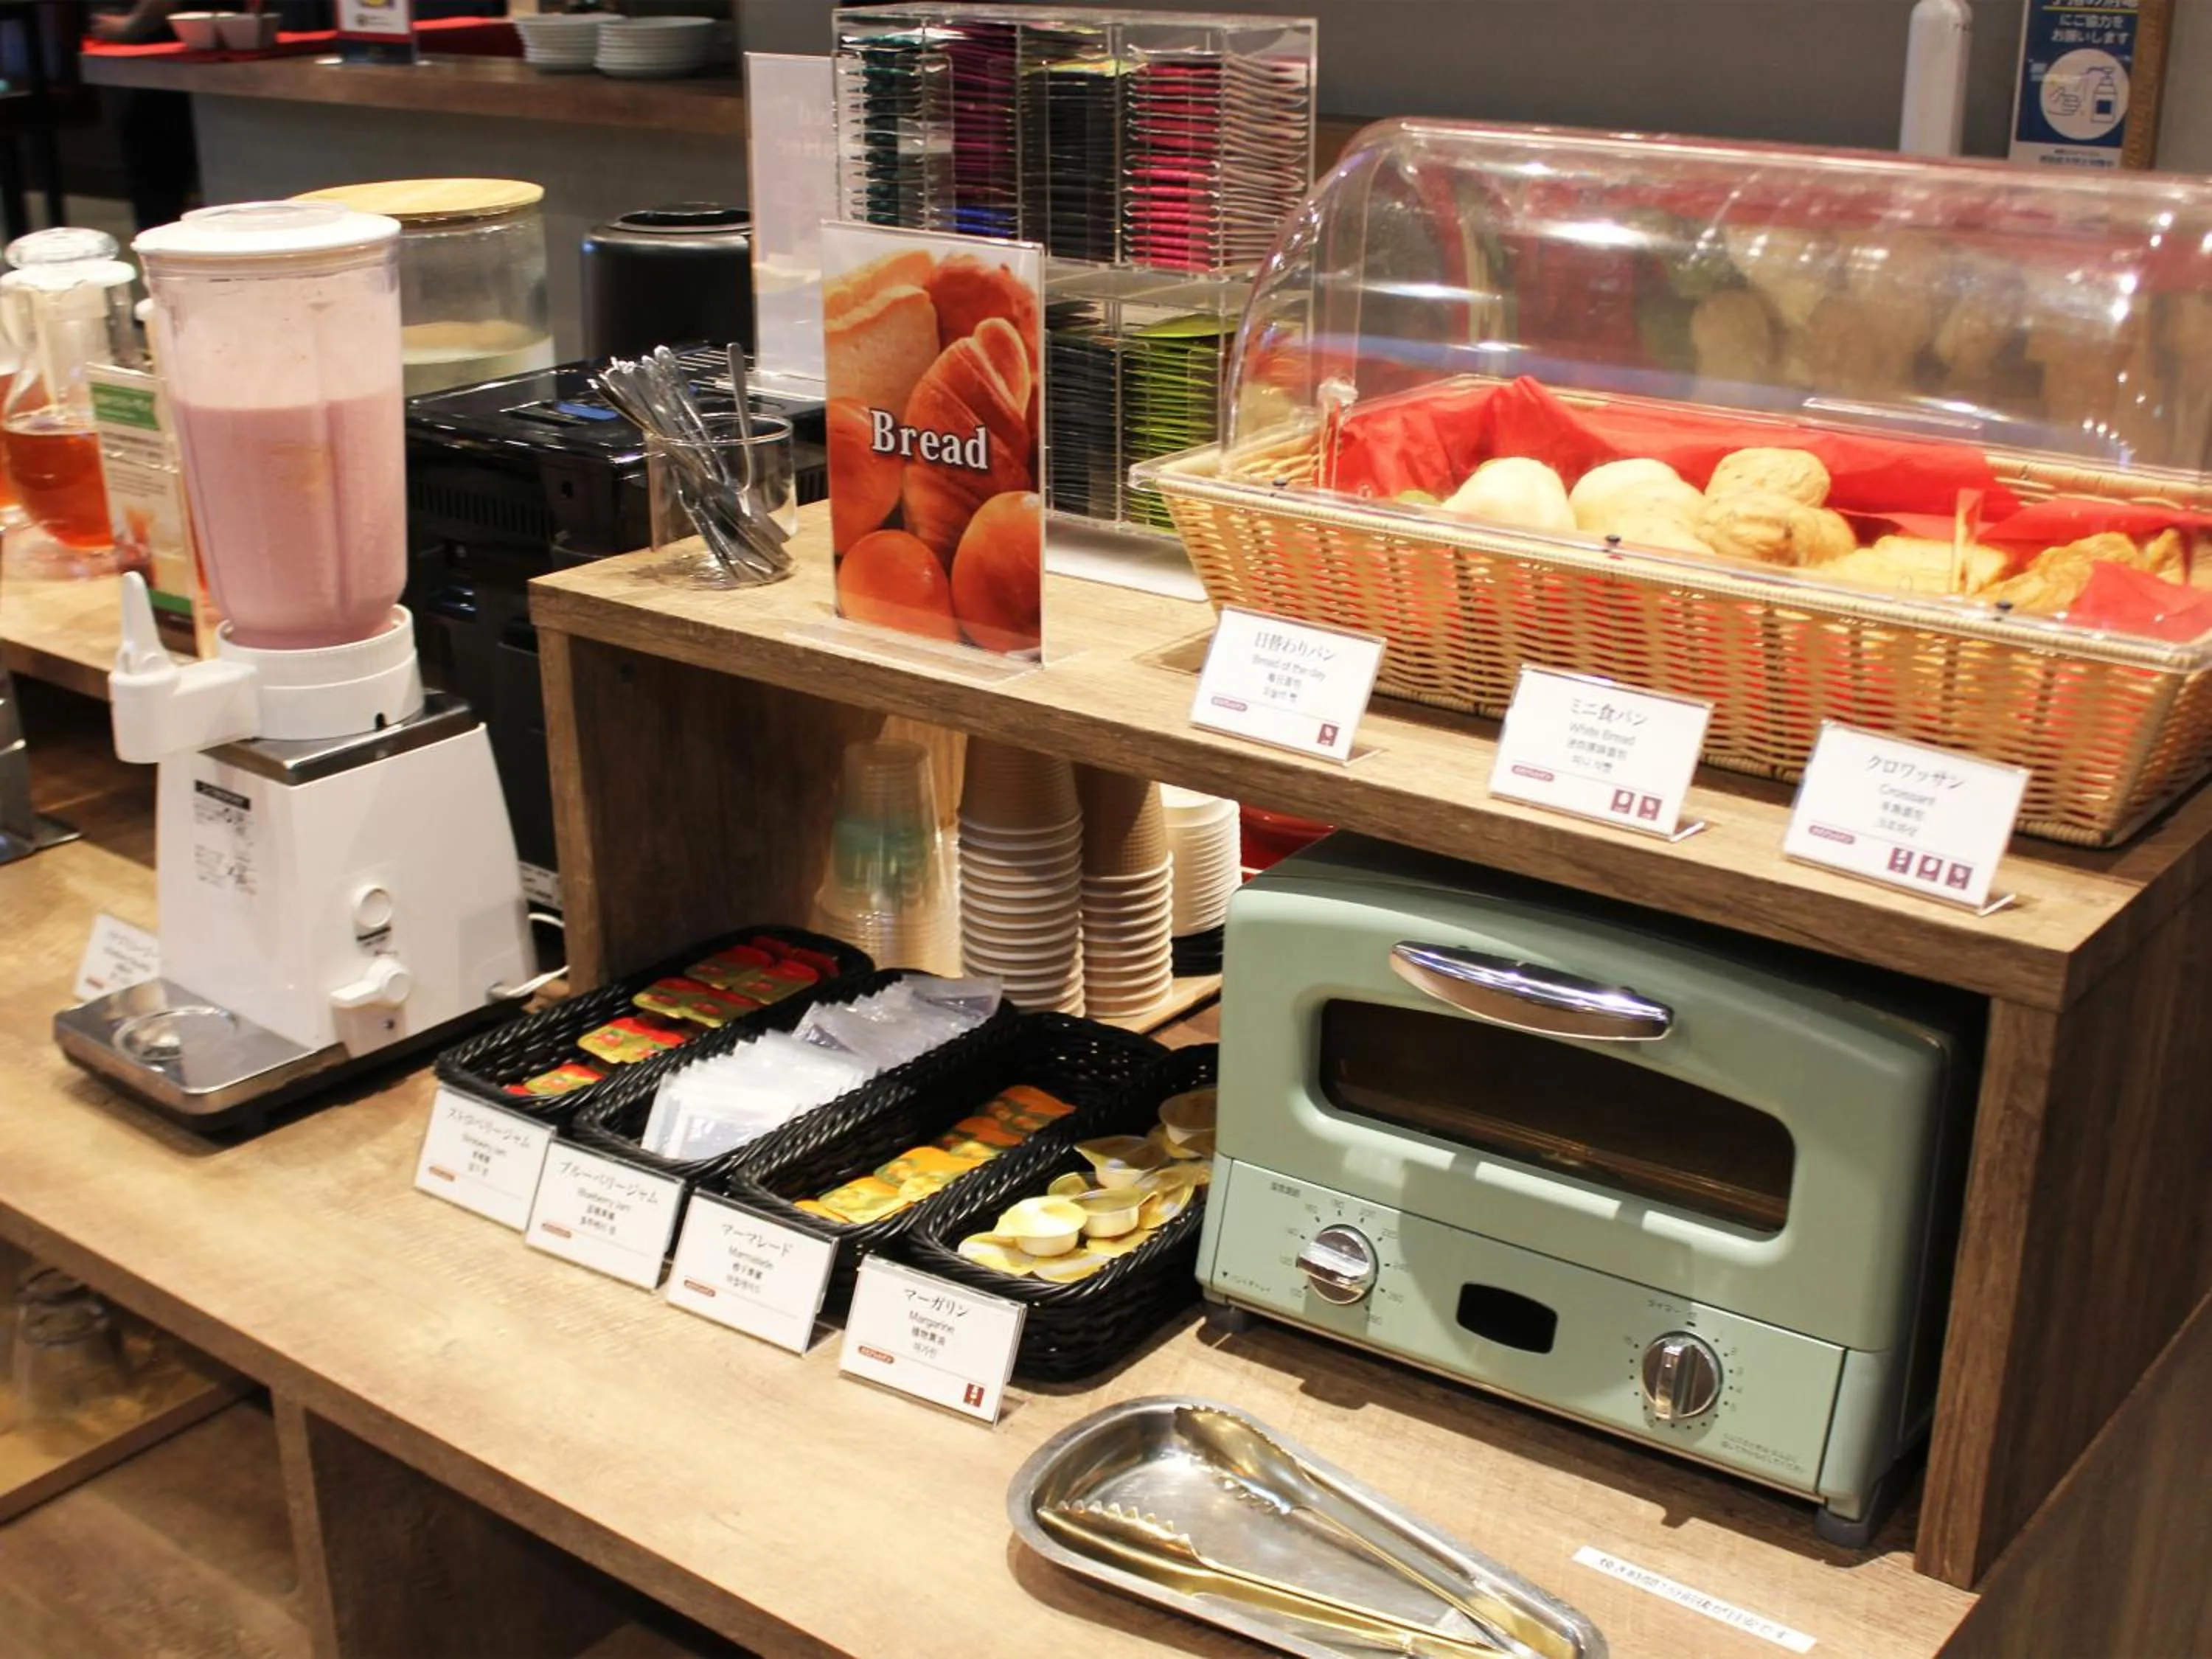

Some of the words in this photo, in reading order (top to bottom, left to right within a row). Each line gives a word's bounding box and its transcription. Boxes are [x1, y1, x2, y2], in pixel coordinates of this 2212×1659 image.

[869, 408, 988, 470] Bread
[1254, 630, 1336, 661] 日替わりパン
[1571, 698, 1648, 727] ミニ食パン
[1866, 754, 1966, 790] クロワッサン
[904, 1288, 971, 1318] マーガリン
